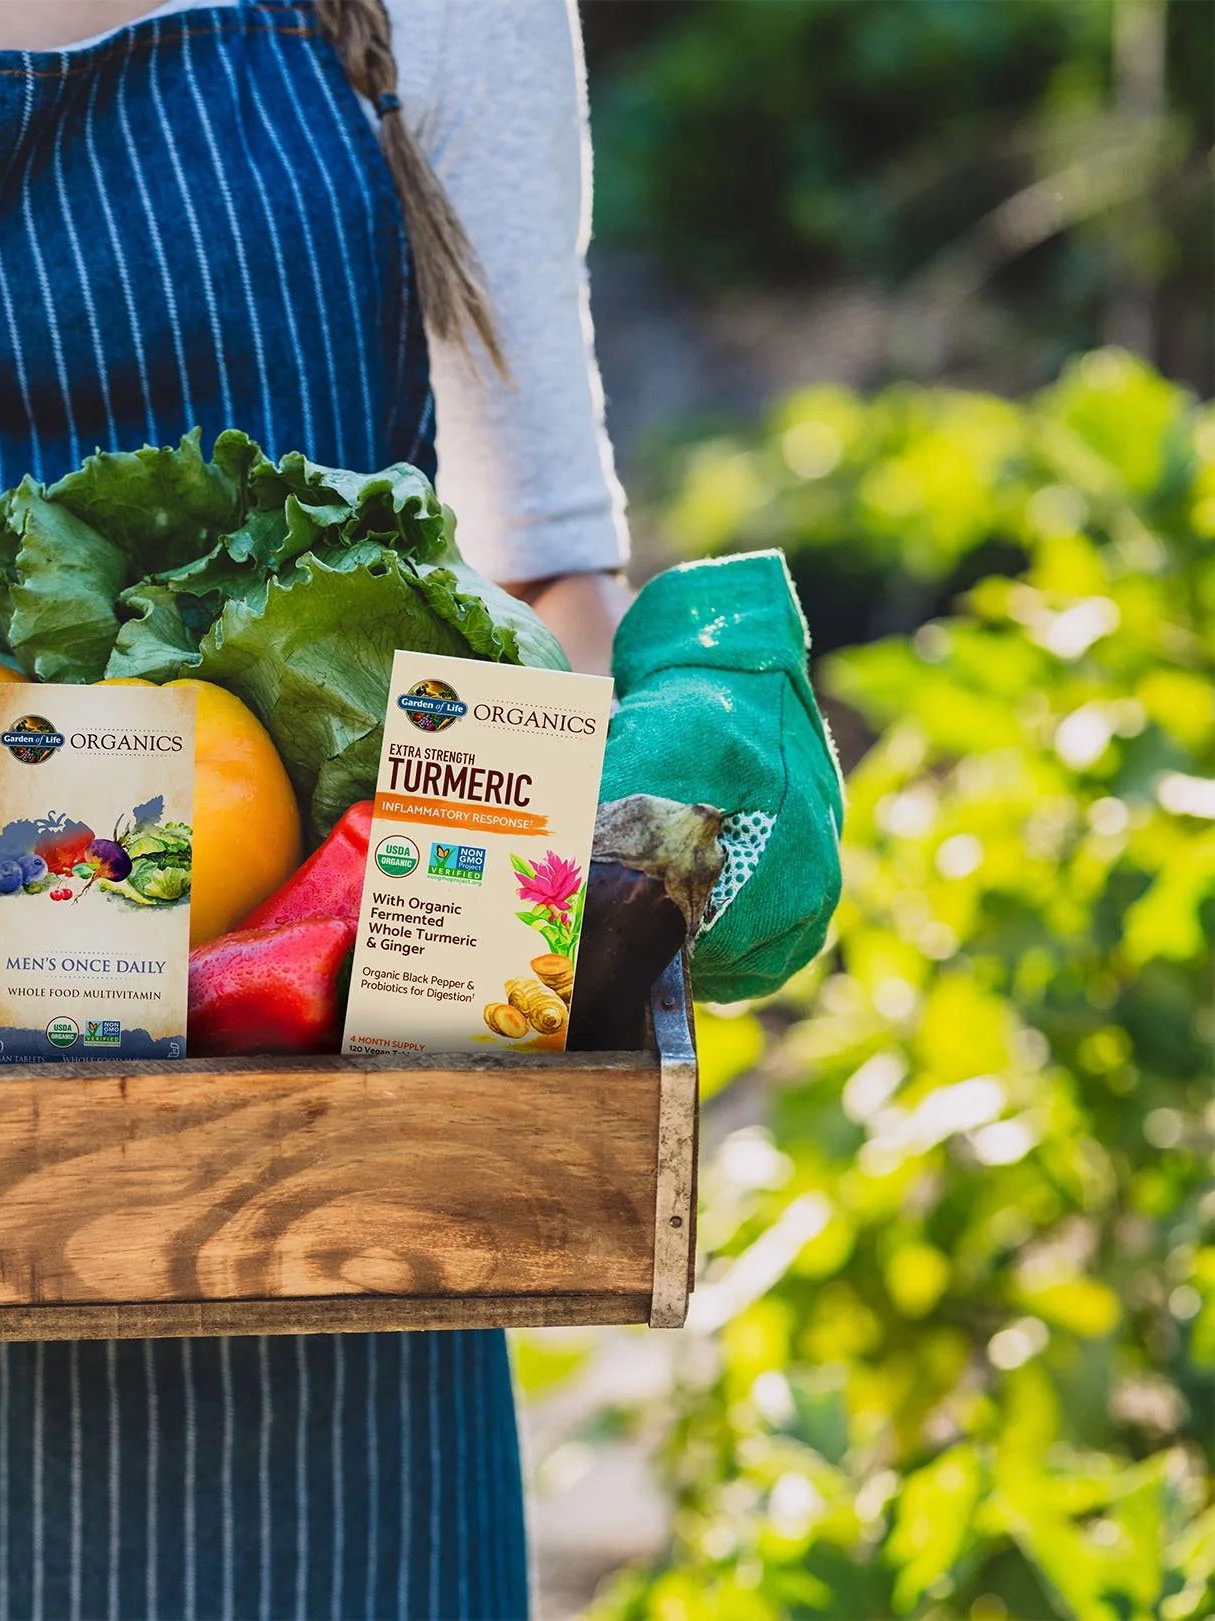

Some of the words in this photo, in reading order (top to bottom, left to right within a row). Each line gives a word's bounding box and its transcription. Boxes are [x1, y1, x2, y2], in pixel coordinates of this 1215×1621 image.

[401, 698, 434, 710] Garden
[436, 702, 445, 712] of
[447, 704, 464, 714] Life
[474, 704, 596, 735] ORGANICS
[4, 734, 34, 743] Garden
[35, 736, 44, 745] of
[45, 736, 61, 744] Life
[70, 733, 182, 752] ORGANICS
[390, 743, 422, 759] EXTRA
[424, 748, 476, 766] STRENGTH
[388, 757, 533, 807] TURMERIC
[382, 801, 470, 822] INFLAMMATORY
[386, 844, 410, 856] USDA
[460, 848, 484, 858] NON
[381, 856, 412, 868] ORGANIC
[458, 863, 482, 871] Project
[459, 856, 483, 864] GMO
[432, 867, 481, 880] VERIFIED
[372, 892, 405, 908] With
[408, 897, 462, 915] Organic
[370, 908, 444, 928] Fermented
[368, 922, 412, 939] Whole
[416, 928, 478, 948] Turmeric
[366, 937, 377, 948] &
[380, 940, 426, 956] Ginger
[6, 957, 56, 972] MEN'S
[61, 958, 110, 972] ONCE
[116, 960, 166, 974] DAILY
[362, 966, 400, 981] Organic
[402, 972, 429, 984] Black
[430, 976, 466, 990] Pepper
[466, 980, 475, 990] &
[8, 987, 46, 997] WHOLE
[49, 988, 80, 998] FOOD
[83, 990, 162, 1000] MULTIVITAMIN
[360, 980, 408, 995] Probiotics
[410, 985, 424, 996] for
[54, 1024, 72, 1032] USDA
[358, 1036, 390, 1047] MONTH
[392, 1040, 426, 1052] SUPPLY
[14, 1056, 45, 1064] TABLETS
